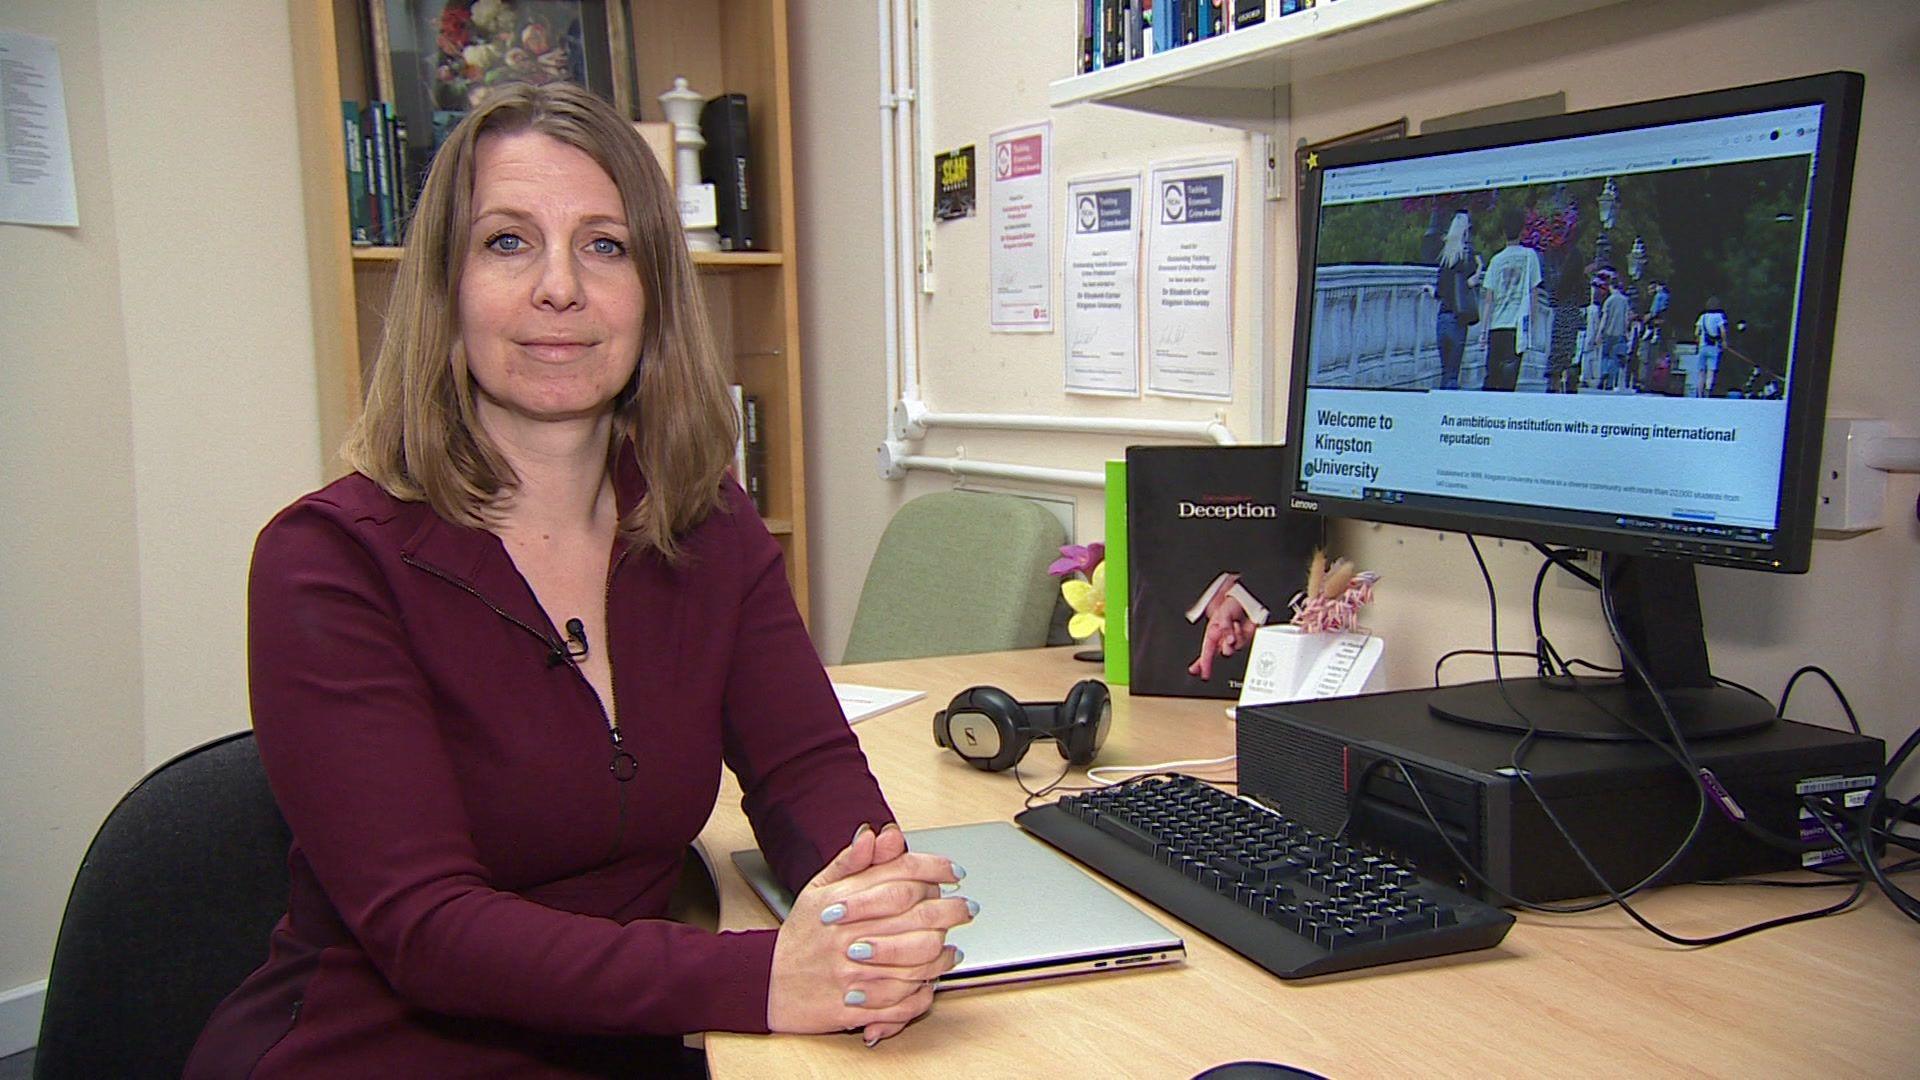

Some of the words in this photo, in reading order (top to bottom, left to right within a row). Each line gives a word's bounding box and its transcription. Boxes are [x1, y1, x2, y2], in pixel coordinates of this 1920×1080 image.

[1317, 409, 1377, 429] Welcome
[1379, 414, 1393, 430] to
[1441, 415, 1455, 427] An
[1456, 416, 1506, 430] ambitious
[1507, 417, 1562, 433] institution
[1563, 420, 1588, 435] with
[1590, 424, 1598, 435] a
[1600, 423, 1650, 440] growing
[1652, 424, 1736, 442] international
[1315, 433, 1373, 456] Kingston
[1440, 433, 1491, 446] reputation
[1314, 458, 1379, 483] University
[1178, 502, 1277, 520] Deception
[1290, 498, 1318, 511] Lenovo
